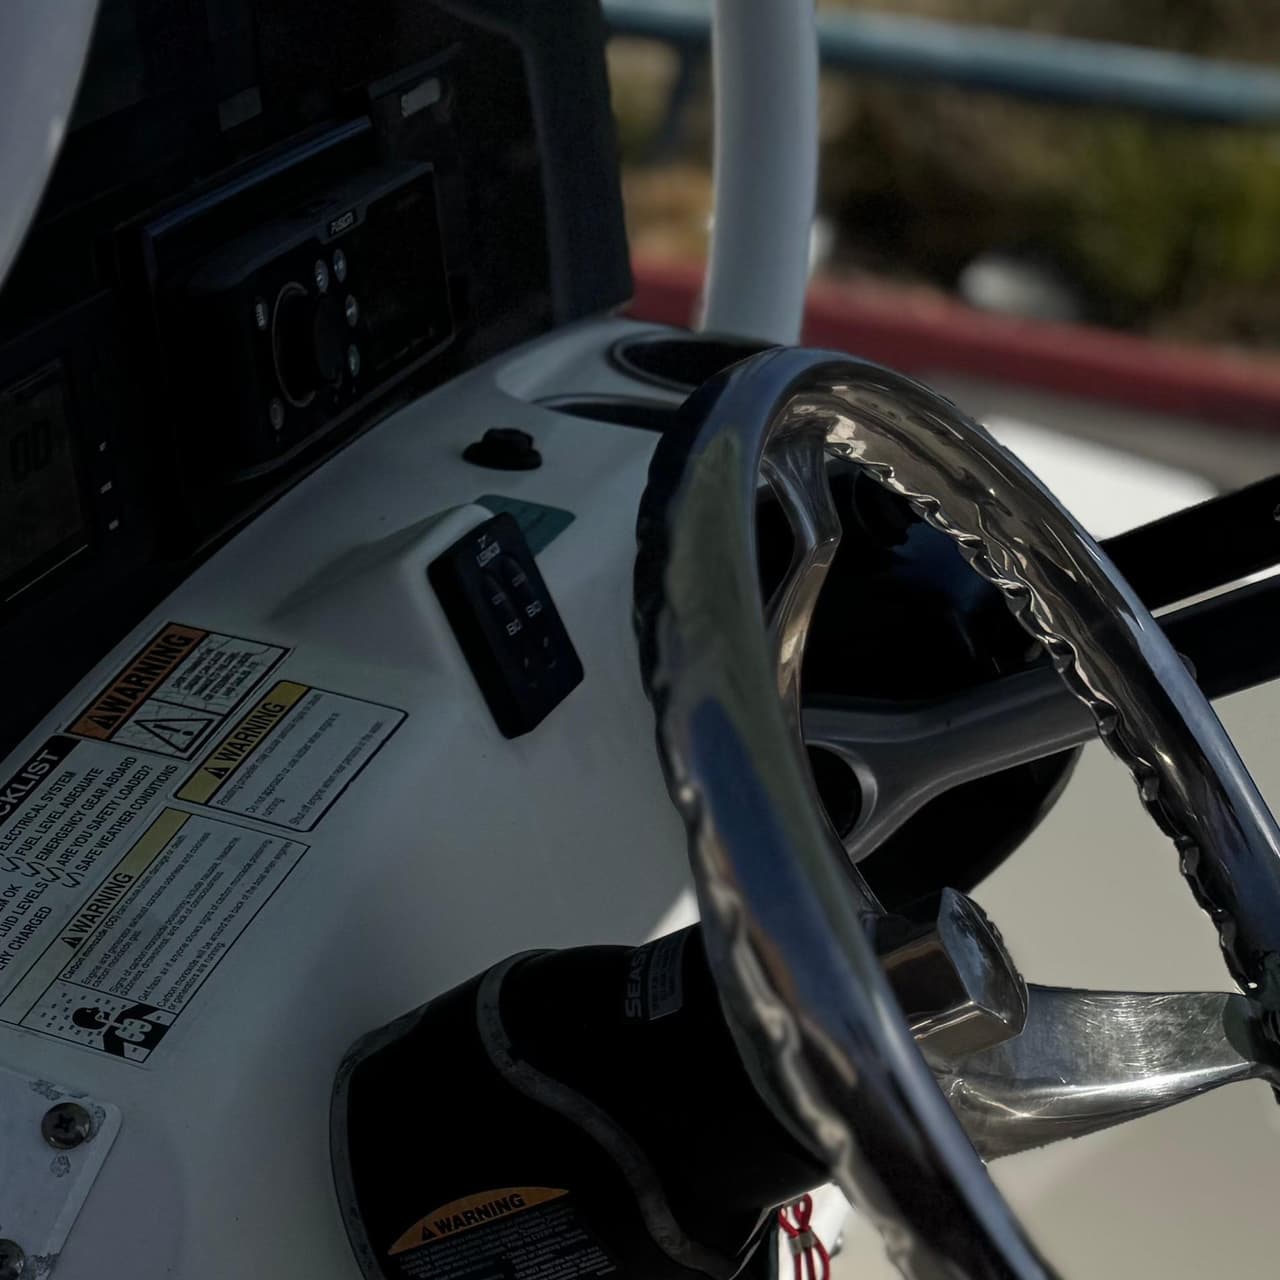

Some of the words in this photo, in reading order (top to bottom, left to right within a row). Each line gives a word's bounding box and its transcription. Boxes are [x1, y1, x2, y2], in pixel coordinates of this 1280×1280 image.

[94, 633, 194, 716] WARNING
[213, 702, 286, 762] WARNING
[14, 835, 43, 856] FUEL
[34, 809, 66, 834] LEVEL
[59, 768, 104, 808] ADEQUATE
[35, 810, 87, 861] EMERGENCY
[81, 788, 109, 811] GEAR
[102, 757, 137, 788] ABOARD
[40, 771, 77, 802] SYSTEM
[56, 847, 79, 866] ARE
[69, 830, 93, 847] YOU
[86, 800, 120, 831] SAFETY
[114, 765, 153, 800] LOADED?
[74, 847, 103, 872] SAFE
[93, 810, 137, 848] WEATHER
[130, 765, 178, 810] CONDITIONS
[2, 883, 23, 898] OK
[11, 881, 49, 915] LEVELS
[68, 872, 134, 933] WARNING
[8, 906, 52, 950] CHARGED
[62, 957, 85, 979] Carbon
[103, 915, 120, 928] (CO)
[434, 1193, 526, 1234] WARNING
